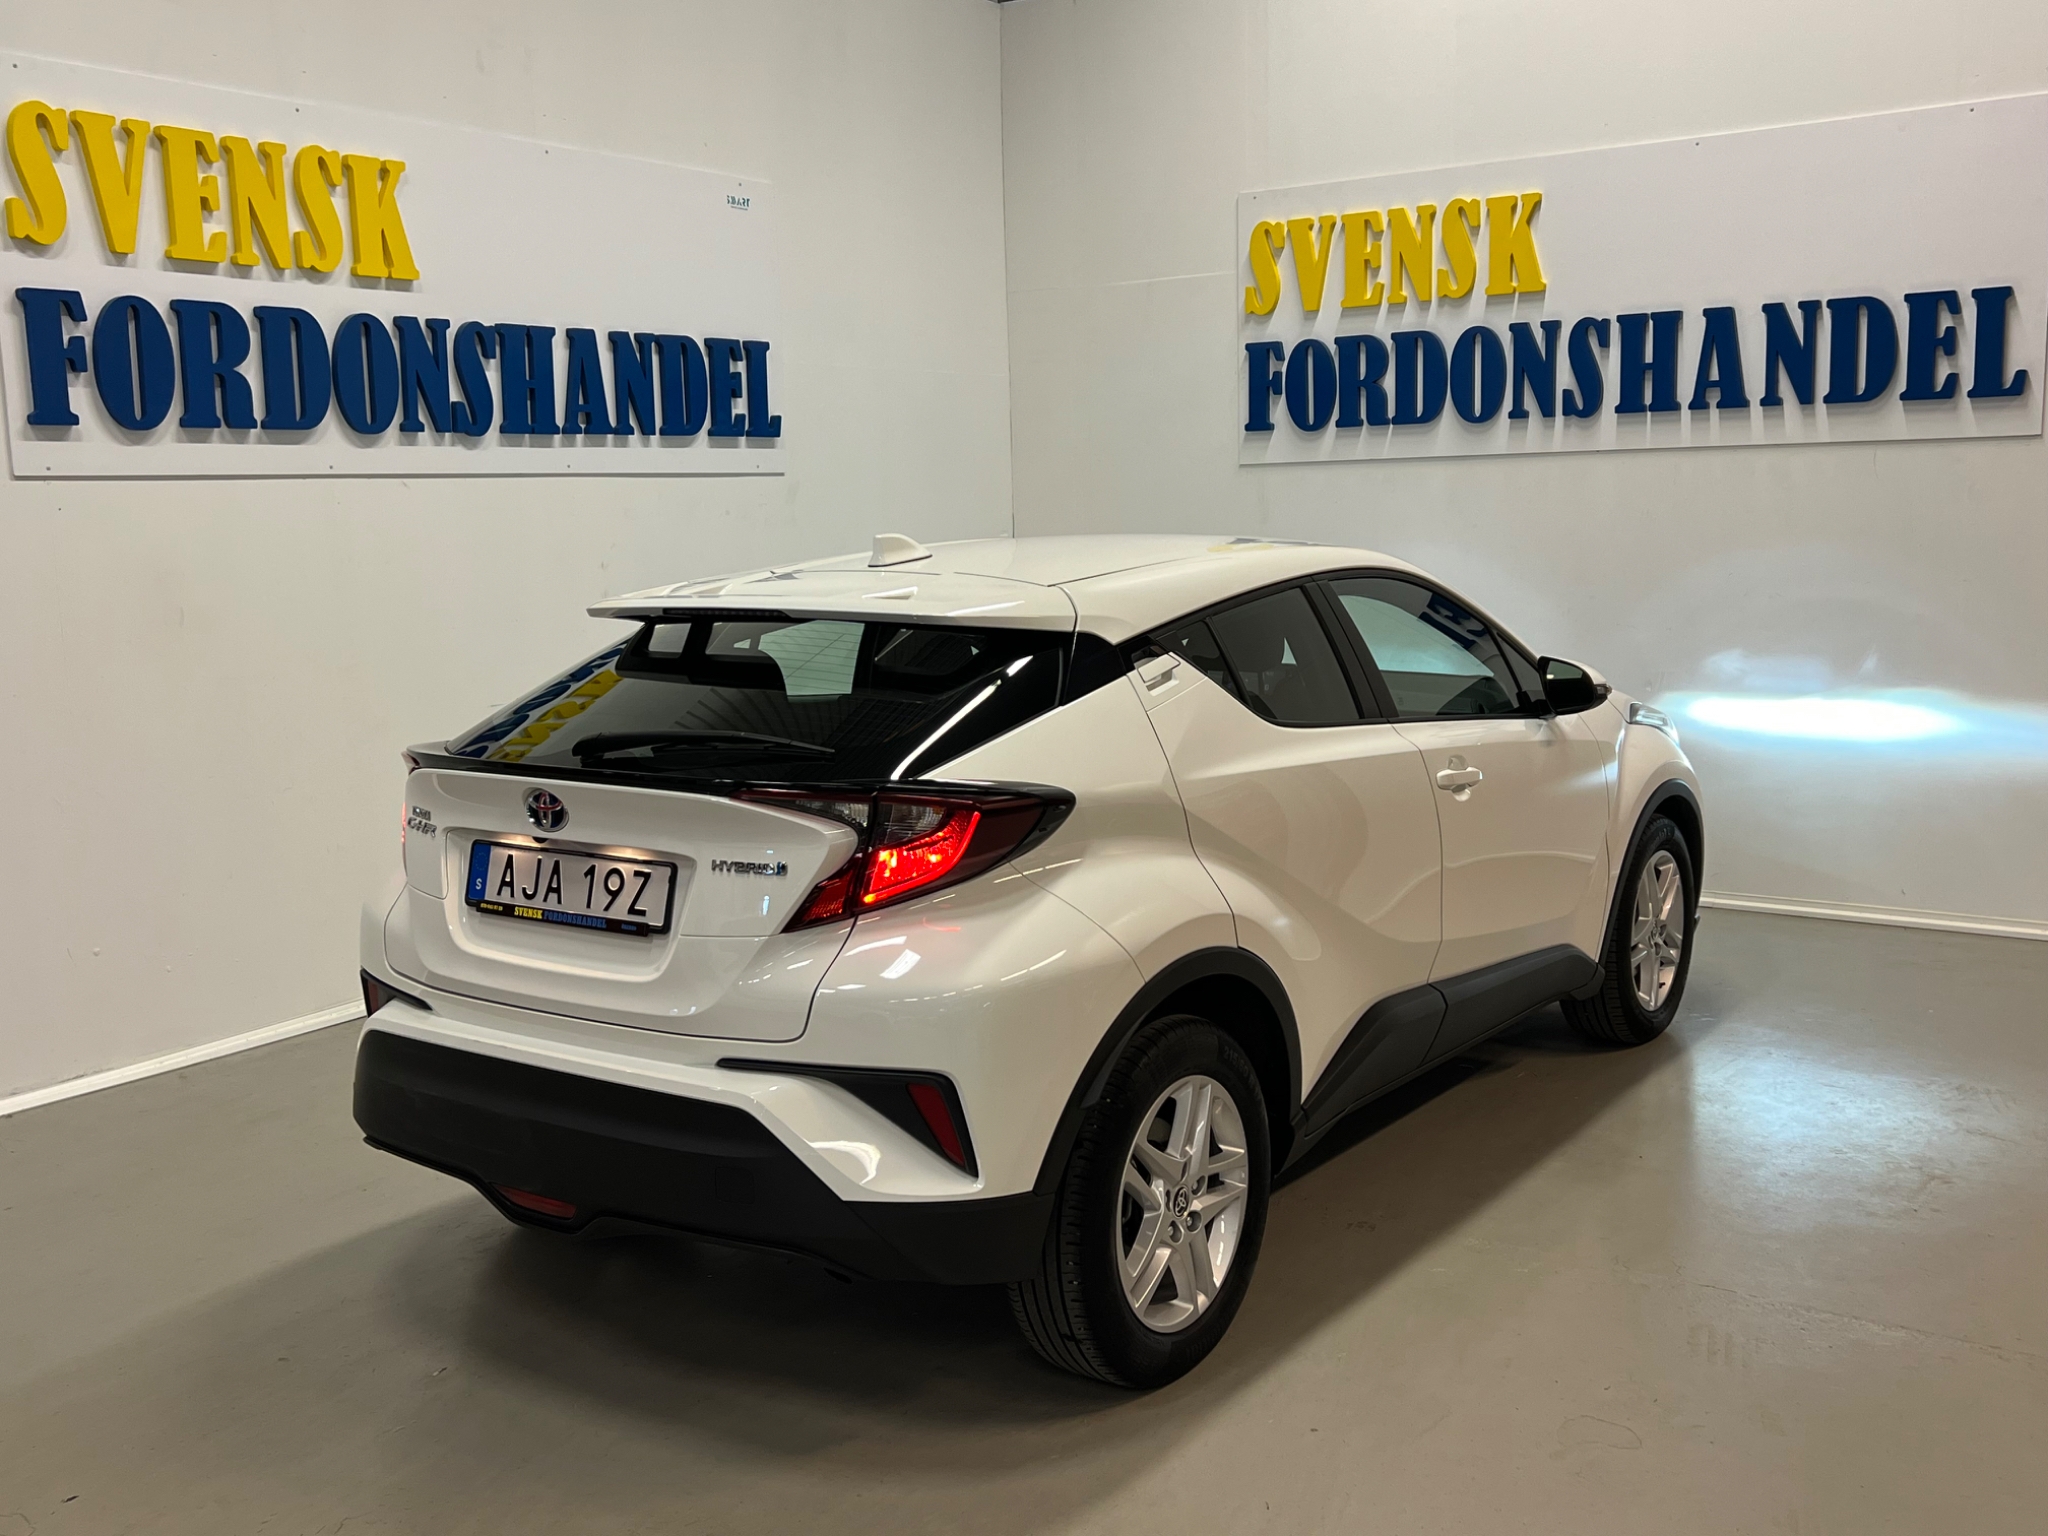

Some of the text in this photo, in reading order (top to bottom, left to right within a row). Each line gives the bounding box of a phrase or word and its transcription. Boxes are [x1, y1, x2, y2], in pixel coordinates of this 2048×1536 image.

[4, 100, 420, 282] SVENSK
[1244, 191, 1547, 316] SVENSK
[15, 287, 782, 438] FORDONSHANDEL
[1244, 285, 2028, 432] FORDONSHANDEL
[475, 877, 483, 890] S
[496, 853, 653, 917] AJA 19Z
[711, 858, 775, 876] HYBRID
[514, 906, 543, 919] SVENSK
[543, 912, 607, 928] FORDONSHANDEL
